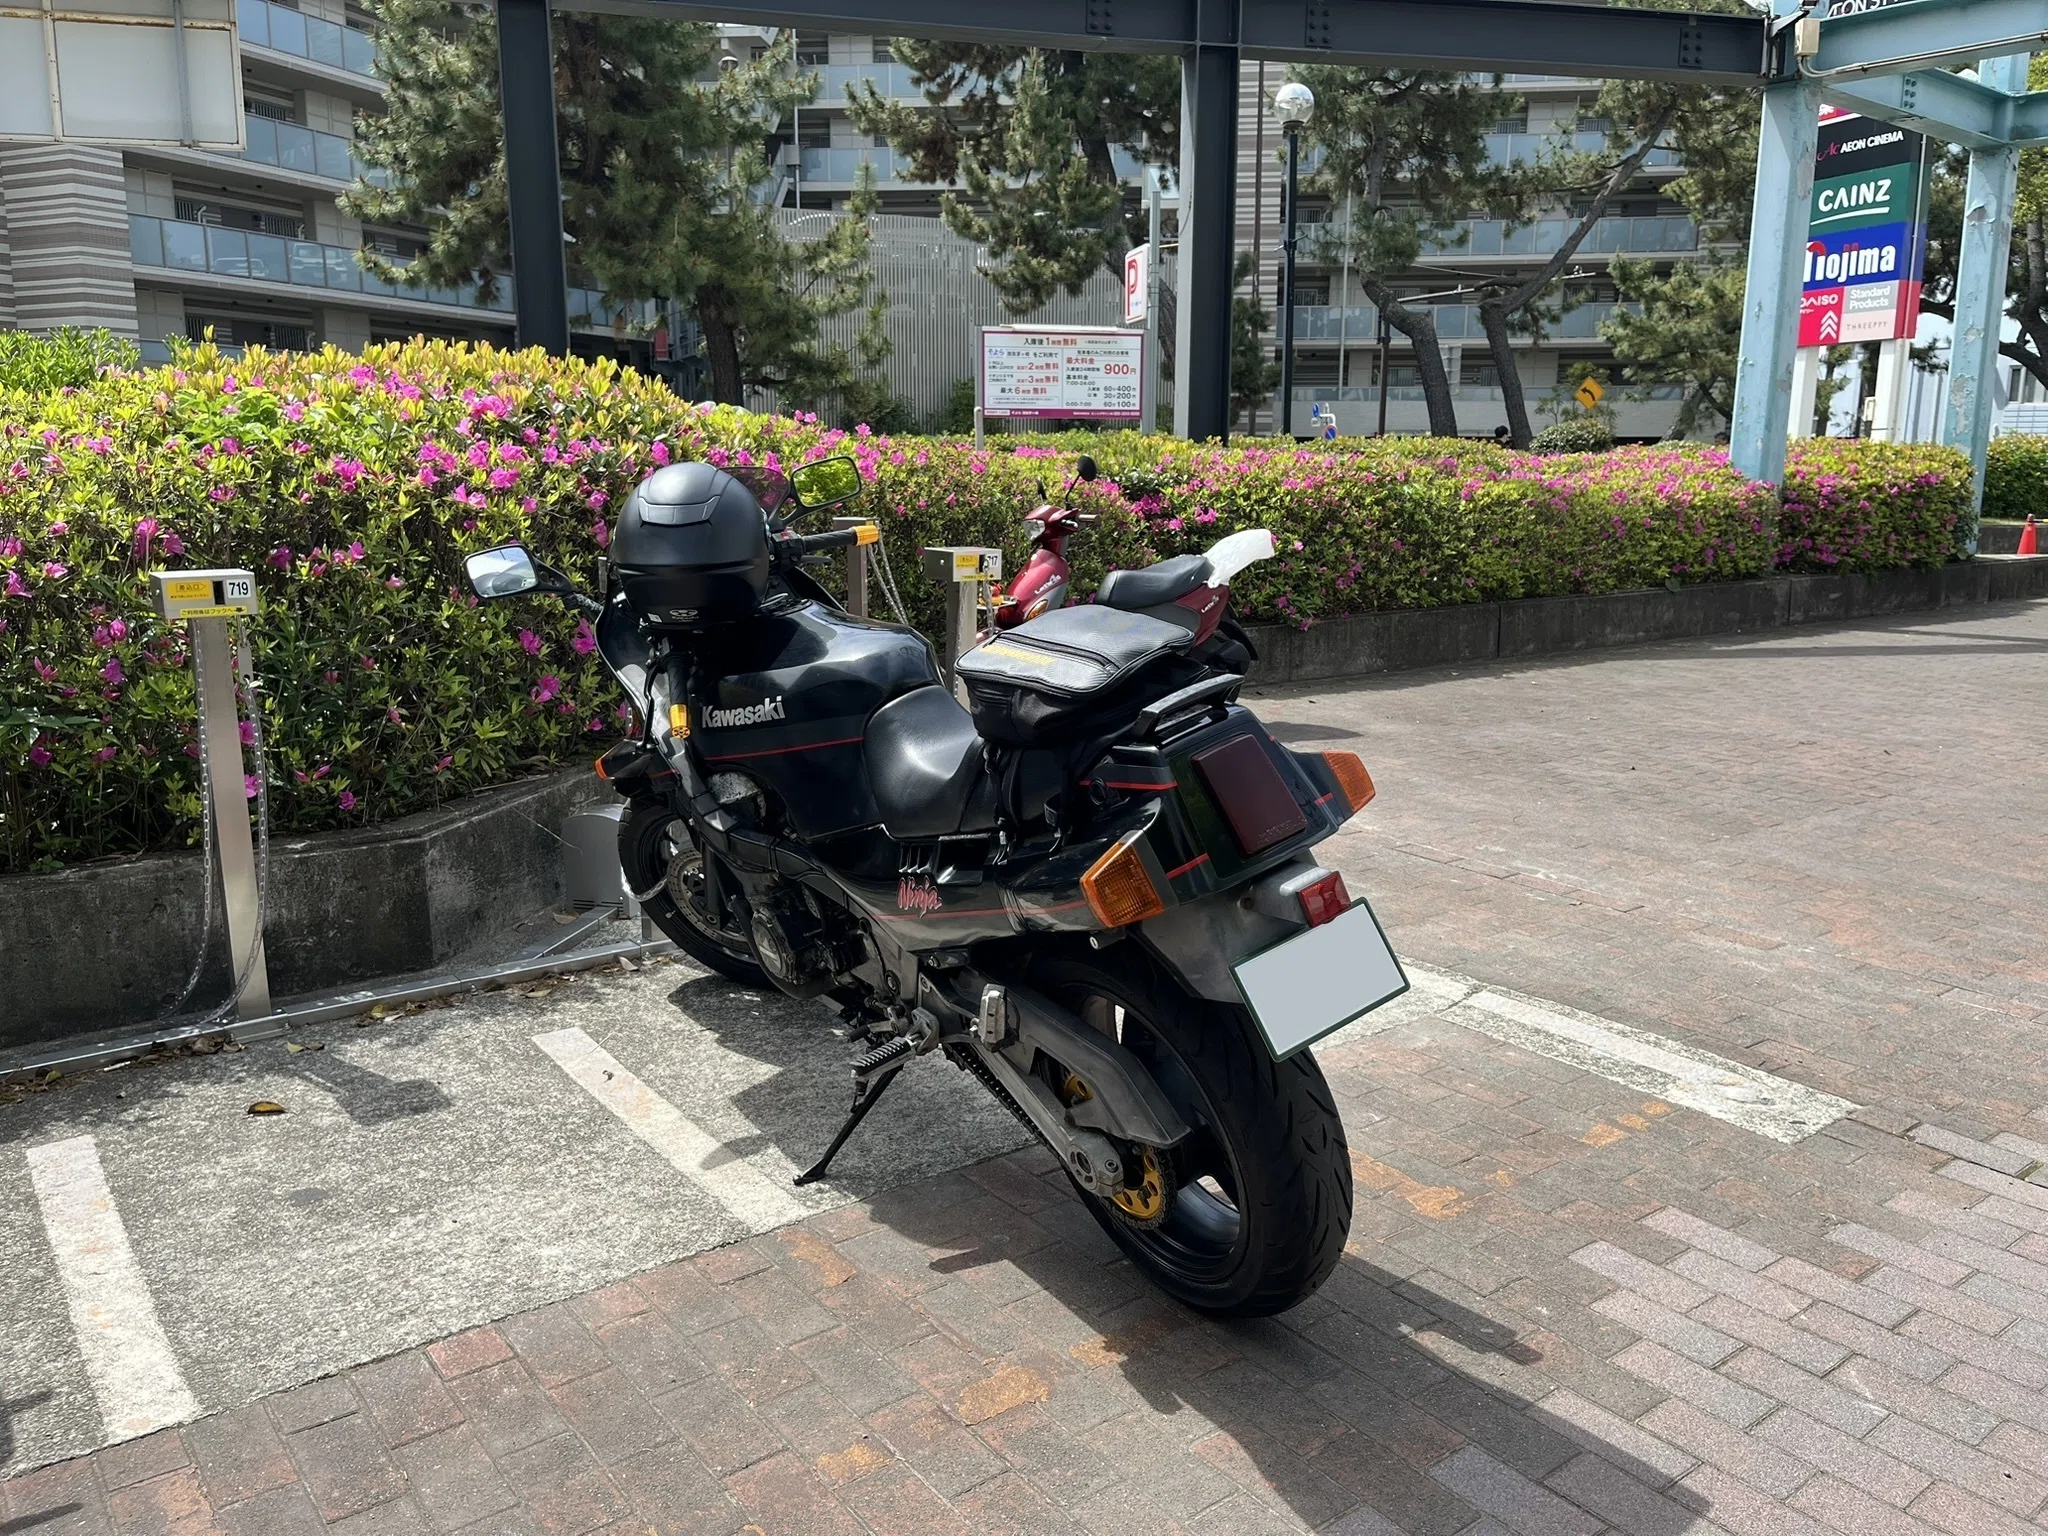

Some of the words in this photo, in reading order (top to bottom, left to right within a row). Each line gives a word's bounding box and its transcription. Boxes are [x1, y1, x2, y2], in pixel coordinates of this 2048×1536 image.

[1840, 139, 1866, 153] AEON
[1867, 131, 1904, 147] CINEMA
[1818, 178, 1892, 212] CAINZ
[1127, 259, 1138, 316] P
[1850, 285, 1891, 299] Standard
[1849, 297, 1889, 310] Products
[1847, 320, 1888, 331] THREEPPY
[228, 581, 249, 597] 719
[702, 696, 786, 728] Kawasaki
[897, 875, 942, 919] Ninja
